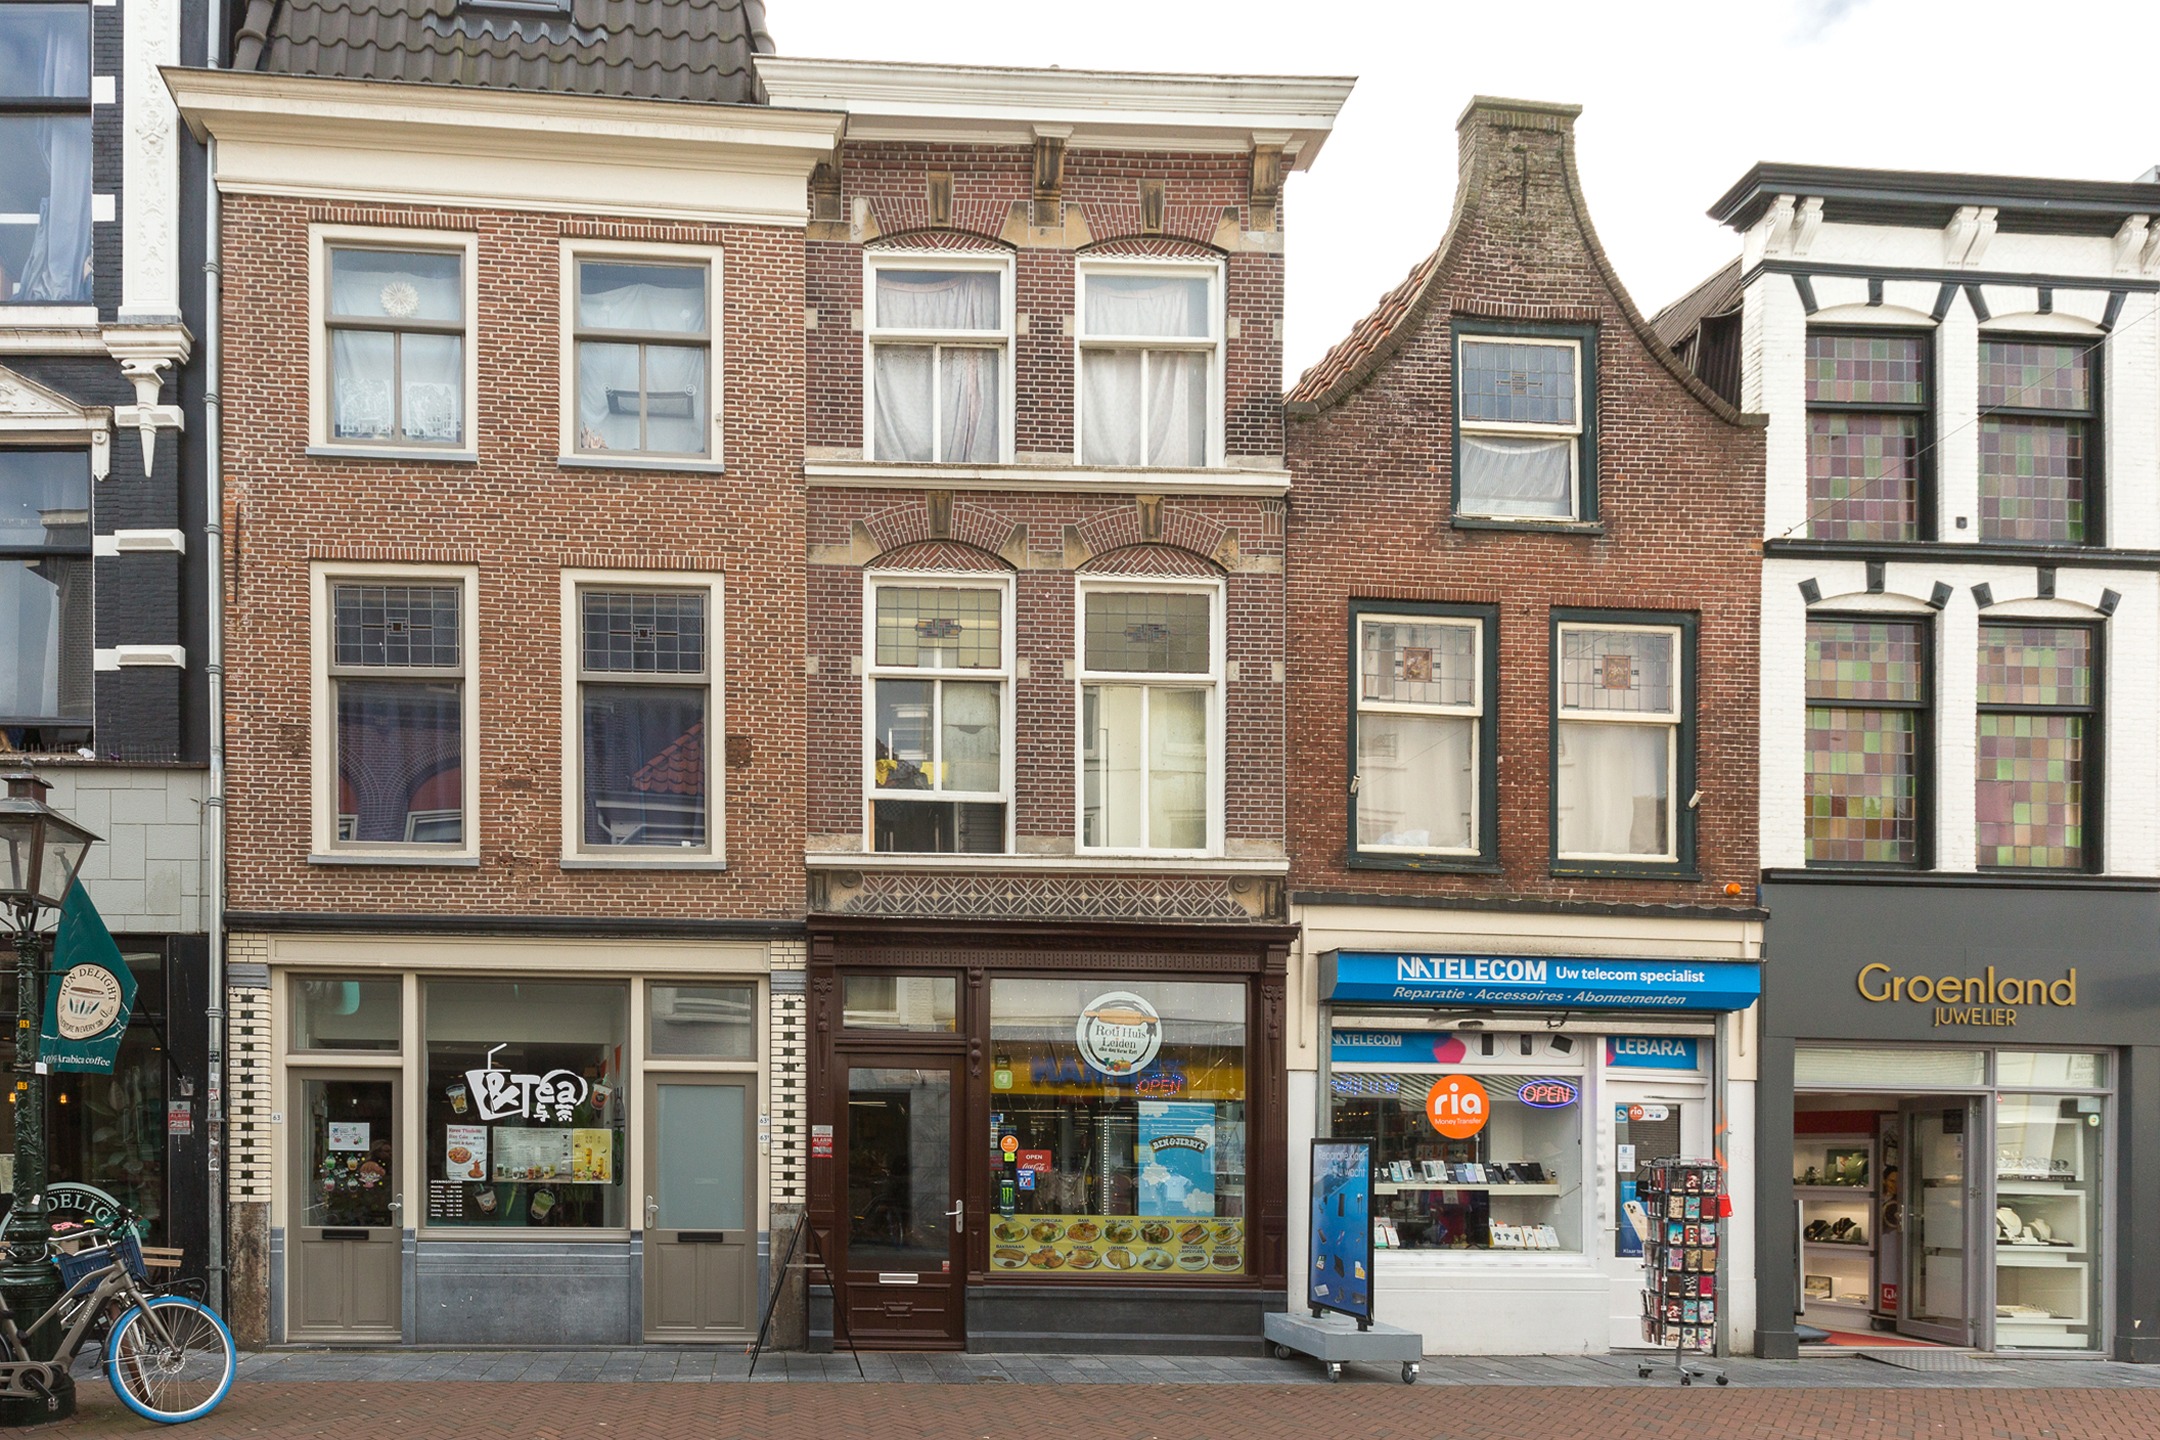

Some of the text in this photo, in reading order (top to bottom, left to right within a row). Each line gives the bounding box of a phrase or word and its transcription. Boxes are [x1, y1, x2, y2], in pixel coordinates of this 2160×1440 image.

[1397, 956, 1705, 984] NATELECOM Uw telecom specialist
[79, 967, 117, 1002] DELIGHT
[1857, 962, 2077, 1007] Groenland
[1393, 986, 1687, 1005] Reparatie Accessoires Abonnementen
[1934, 1006, 2017, 1028] JUWELIER
[1096, 1025, 1147, 1039] Roti Huis
[1102, 1036, 1137, 1049] Leiden
[1615, 1038, 1687, 1056] LEBARA
[85, 1056, 111, 1066] coffee
[1138, 1079, 1181, 1092] OPEN
[1523, 1085, 1571, 1103] OPEN
[1434, 1082, 1482, 1115] ria
[1630, 1106, 1643, 1115] ria
[1434, 1117, 1482, 1126] Money Transfer
